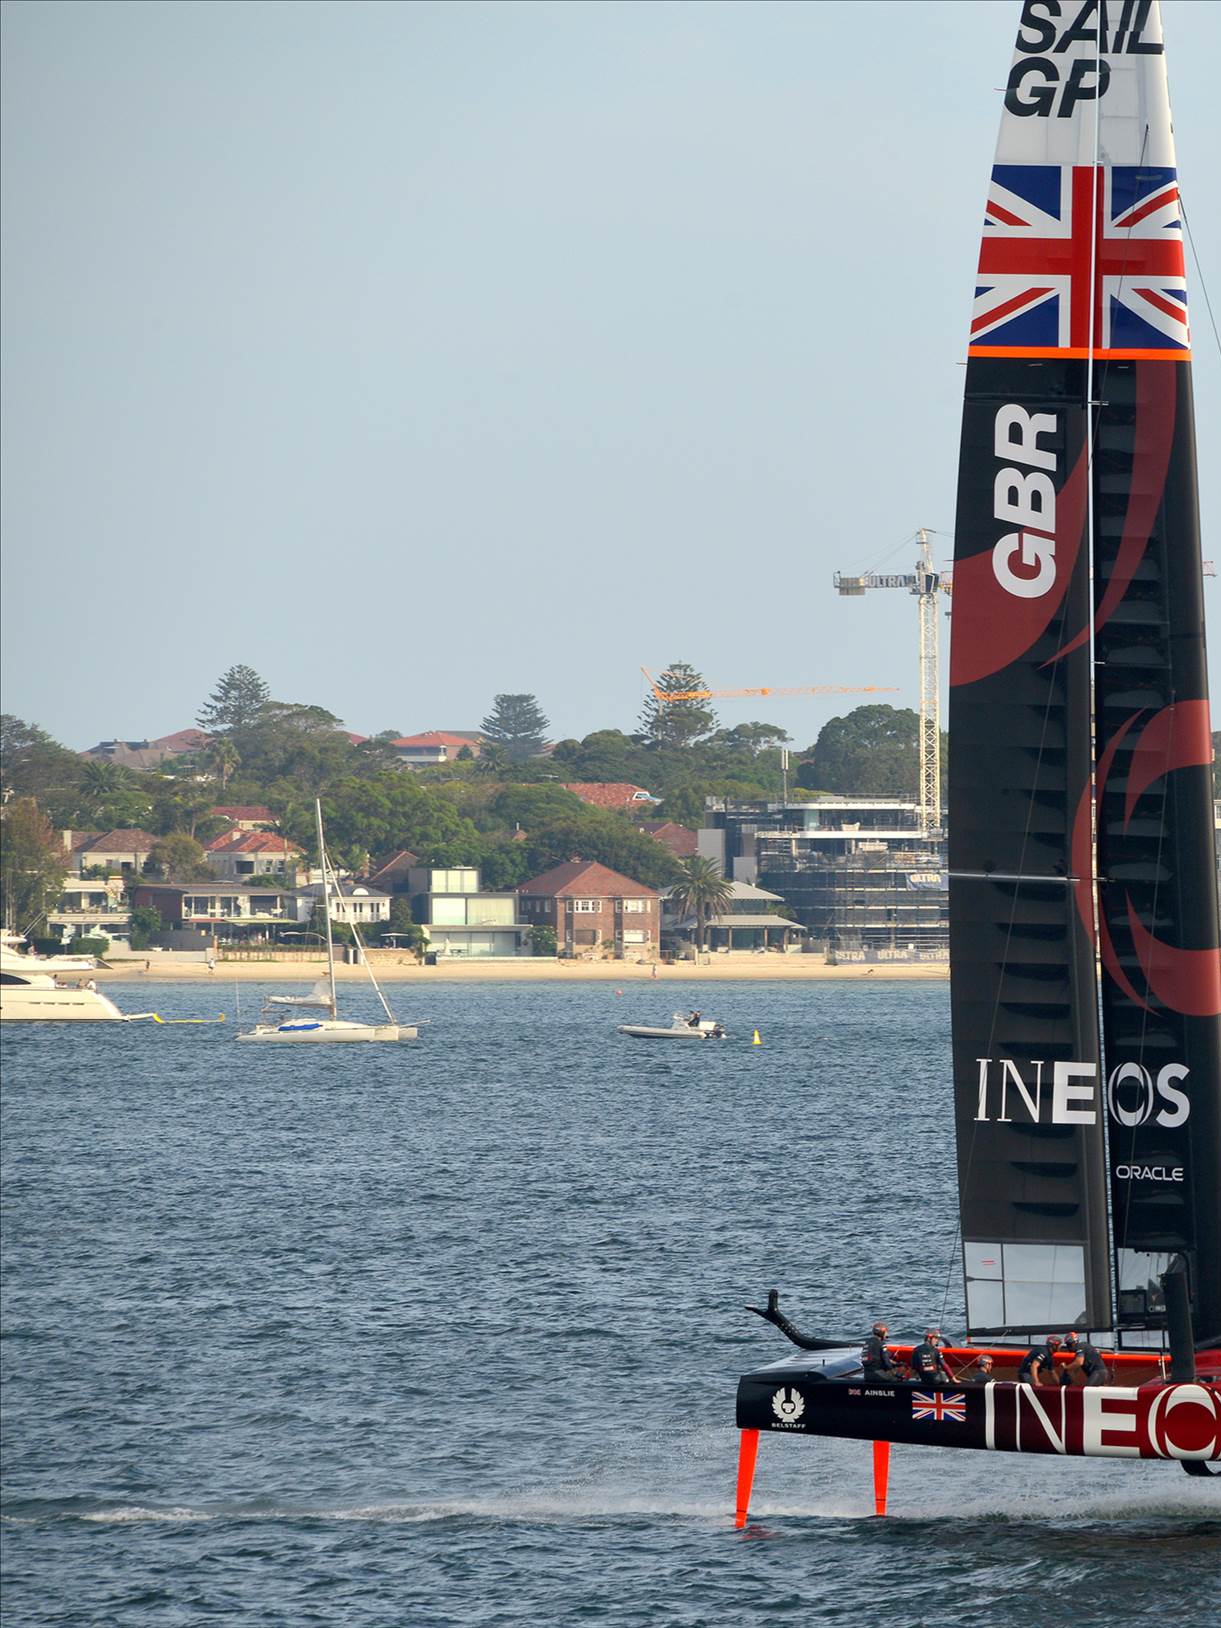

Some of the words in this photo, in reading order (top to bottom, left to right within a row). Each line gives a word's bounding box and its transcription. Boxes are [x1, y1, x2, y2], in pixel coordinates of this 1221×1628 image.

[1016, 0, 1164, 55] SAIL
[1004, 57, 1112, 118] GP
[992, 403, 1057, 599] GBR
[869, 575, 906, 588] ULTRA
[973, 1058, 1191, 1128] INEOS
[1115, 1165, 1184, 1182] ORACLE
[864, 1389, 895, 1397] AINSLIE
